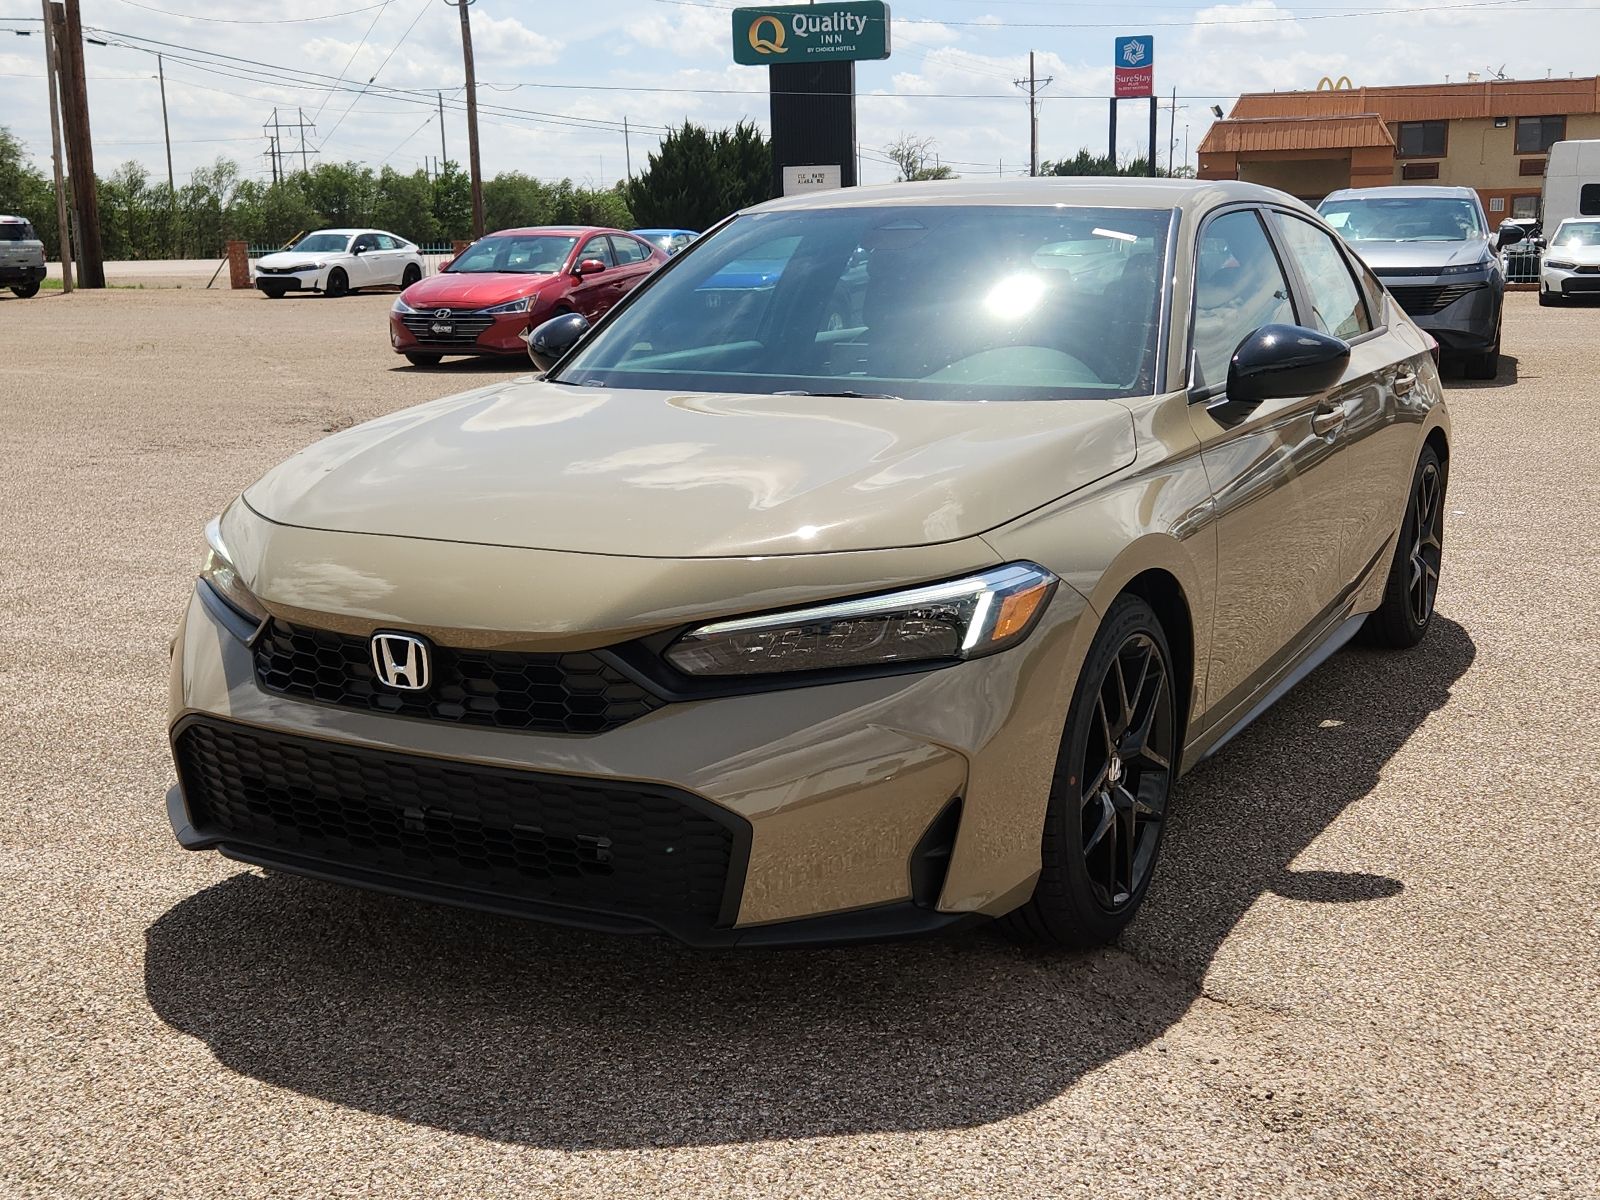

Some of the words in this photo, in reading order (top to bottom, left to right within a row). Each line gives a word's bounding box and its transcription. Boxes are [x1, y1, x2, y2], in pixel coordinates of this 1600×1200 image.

[792, 11, 867, 37] Quality
[820, 34, 842, 44] INN
[1115, 74, 1151, 83] SureStay
